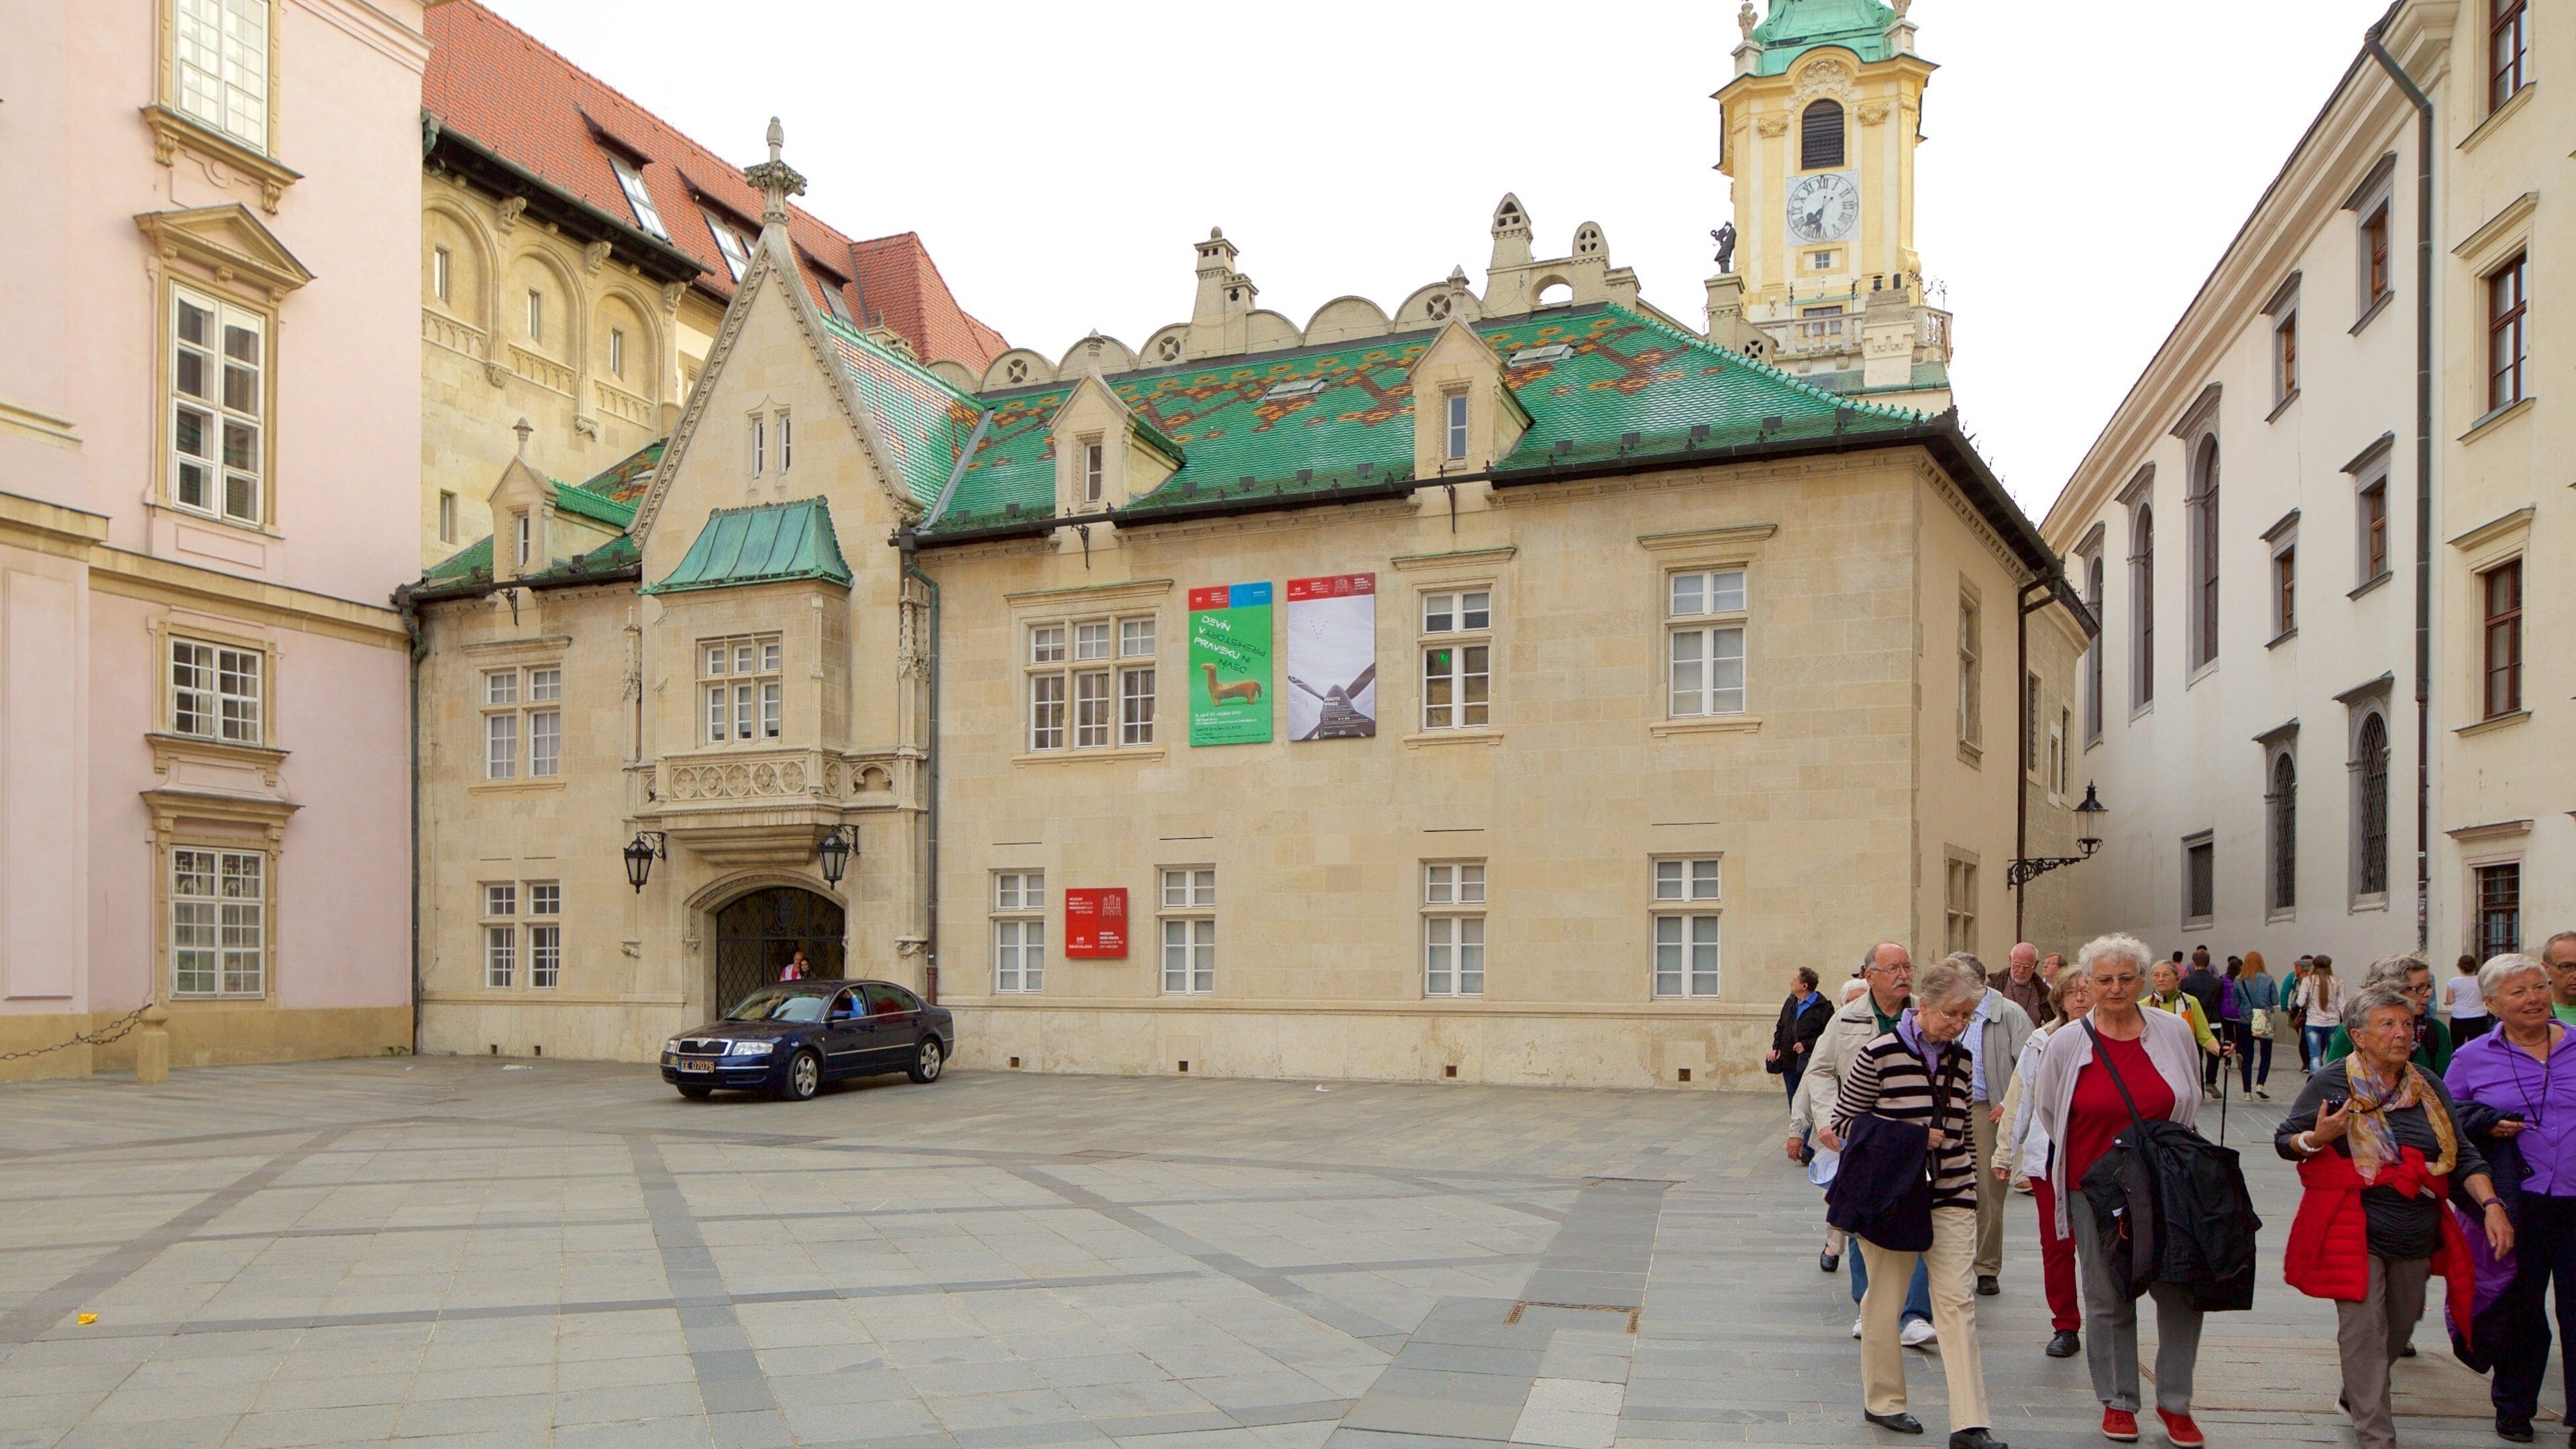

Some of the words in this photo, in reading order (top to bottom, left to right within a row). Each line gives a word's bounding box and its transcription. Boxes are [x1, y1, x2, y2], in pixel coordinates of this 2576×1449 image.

[1201, 615, 1231, 631] DEVÍN
[1199, 626, 1206, 634] V
[1194, 637, 1240, 659] PRAVEKU
[682, 1061, 690, 1069] EE
[692, 1061, 713, 1070] 07075
